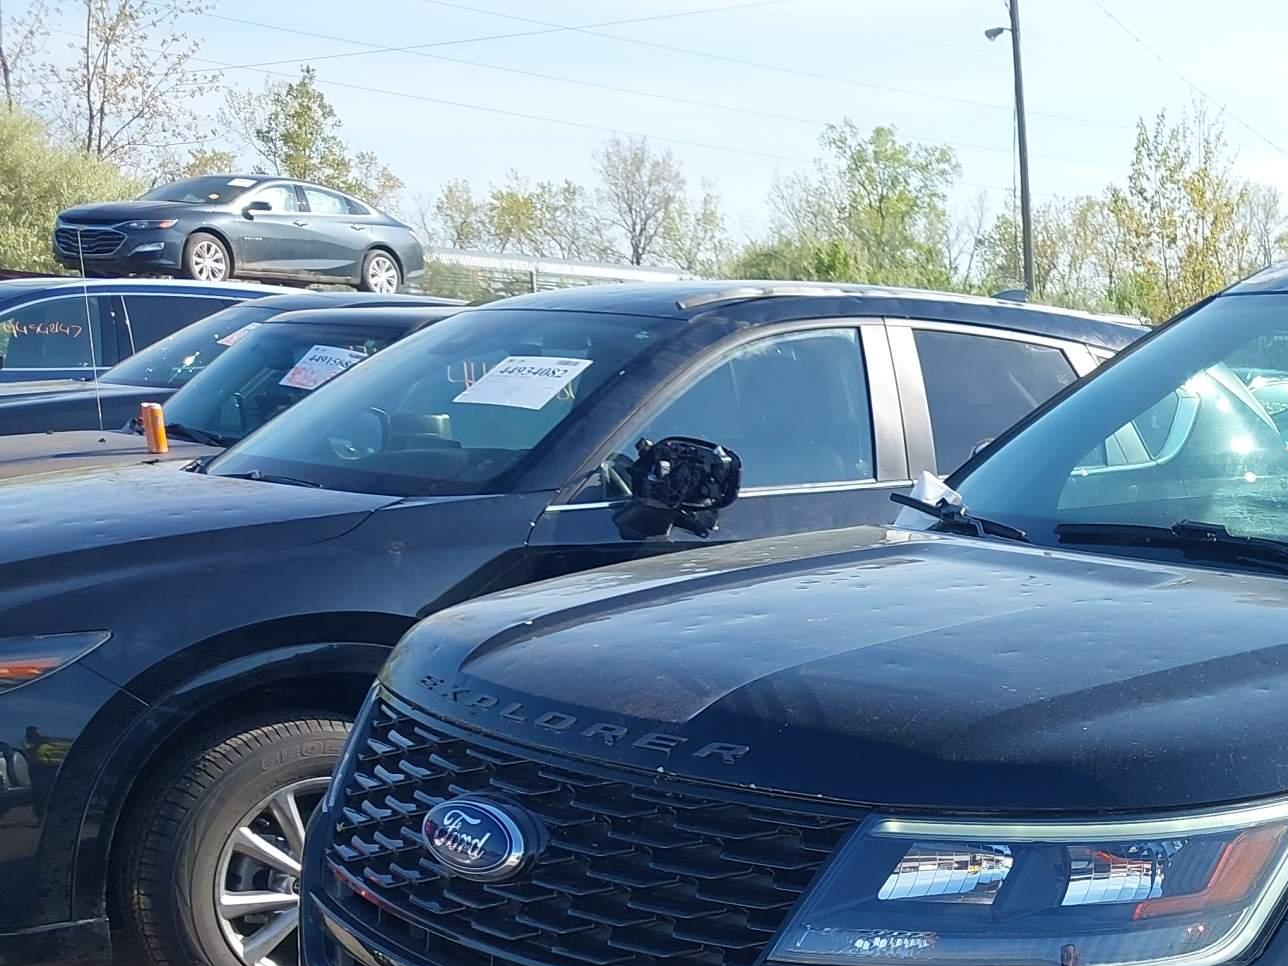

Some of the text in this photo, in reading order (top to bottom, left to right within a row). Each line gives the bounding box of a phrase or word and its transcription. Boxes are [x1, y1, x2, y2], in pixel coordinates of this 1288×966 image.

[499, 365, 569, 379] 44934082
[419, 673, 750, 765] EXPLORER
[433, 809, 491, 860] Ford
